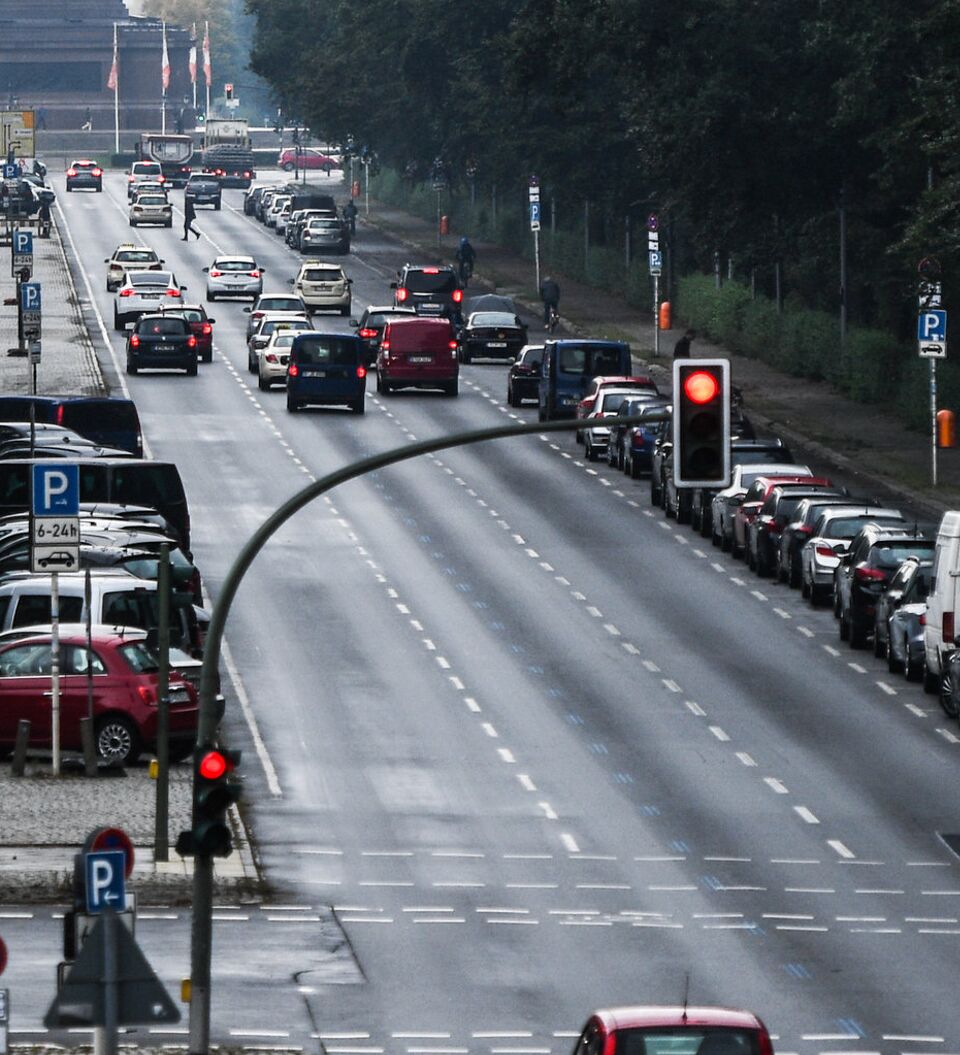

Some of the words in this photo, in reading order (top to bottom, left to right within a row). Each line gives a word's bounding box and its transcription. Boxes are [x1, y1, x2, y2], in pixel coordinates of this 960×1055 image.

[6, 166, 15, 177] P
[532, 205, 539, 219] P
[17, 234, 28, 251] P
[651, 253, 658, 265] P
[26, 286, 37, 308] P
[924, 314, 940, 337] P
[44, 471, 68, 509] P
[37, 524, 77, 538] 6-24h
[92, 860, 113, 905] P
